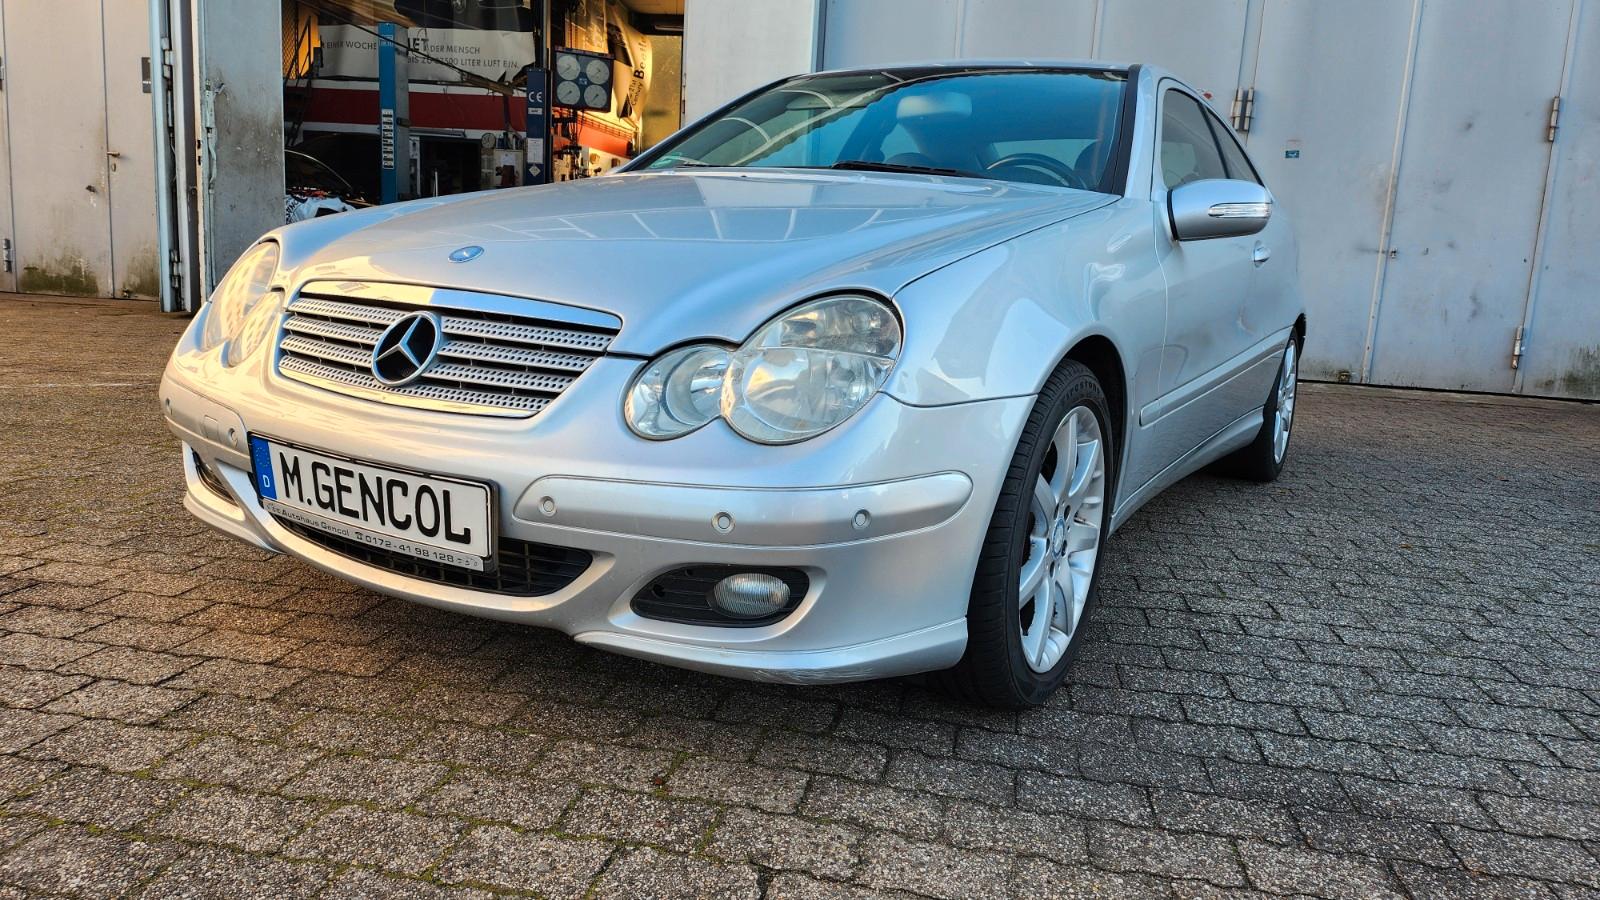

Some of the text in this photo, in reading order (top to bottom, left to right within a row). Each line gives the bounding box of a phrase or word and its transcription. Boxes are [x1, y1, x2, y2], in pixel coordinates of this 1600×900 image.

[345, 40, 377, 50] WOCHE
[430, 45, 445, 53] DER
[446, 45, 481, 55] MENSCH
[460, 58, 481, 67] LITER
[483, 59, 501, 68] LUFT
[528, 91, 543, 103] CE
[263, 474, 270, 488] D
[278, 451, 471, 545] M.GENCOL
[282, 509, 320, 527] Autohaus
[320, 521, 350, 537] Gencol
[414, 547, 430, 557] 98
[433, 551, 454, 563] 128
